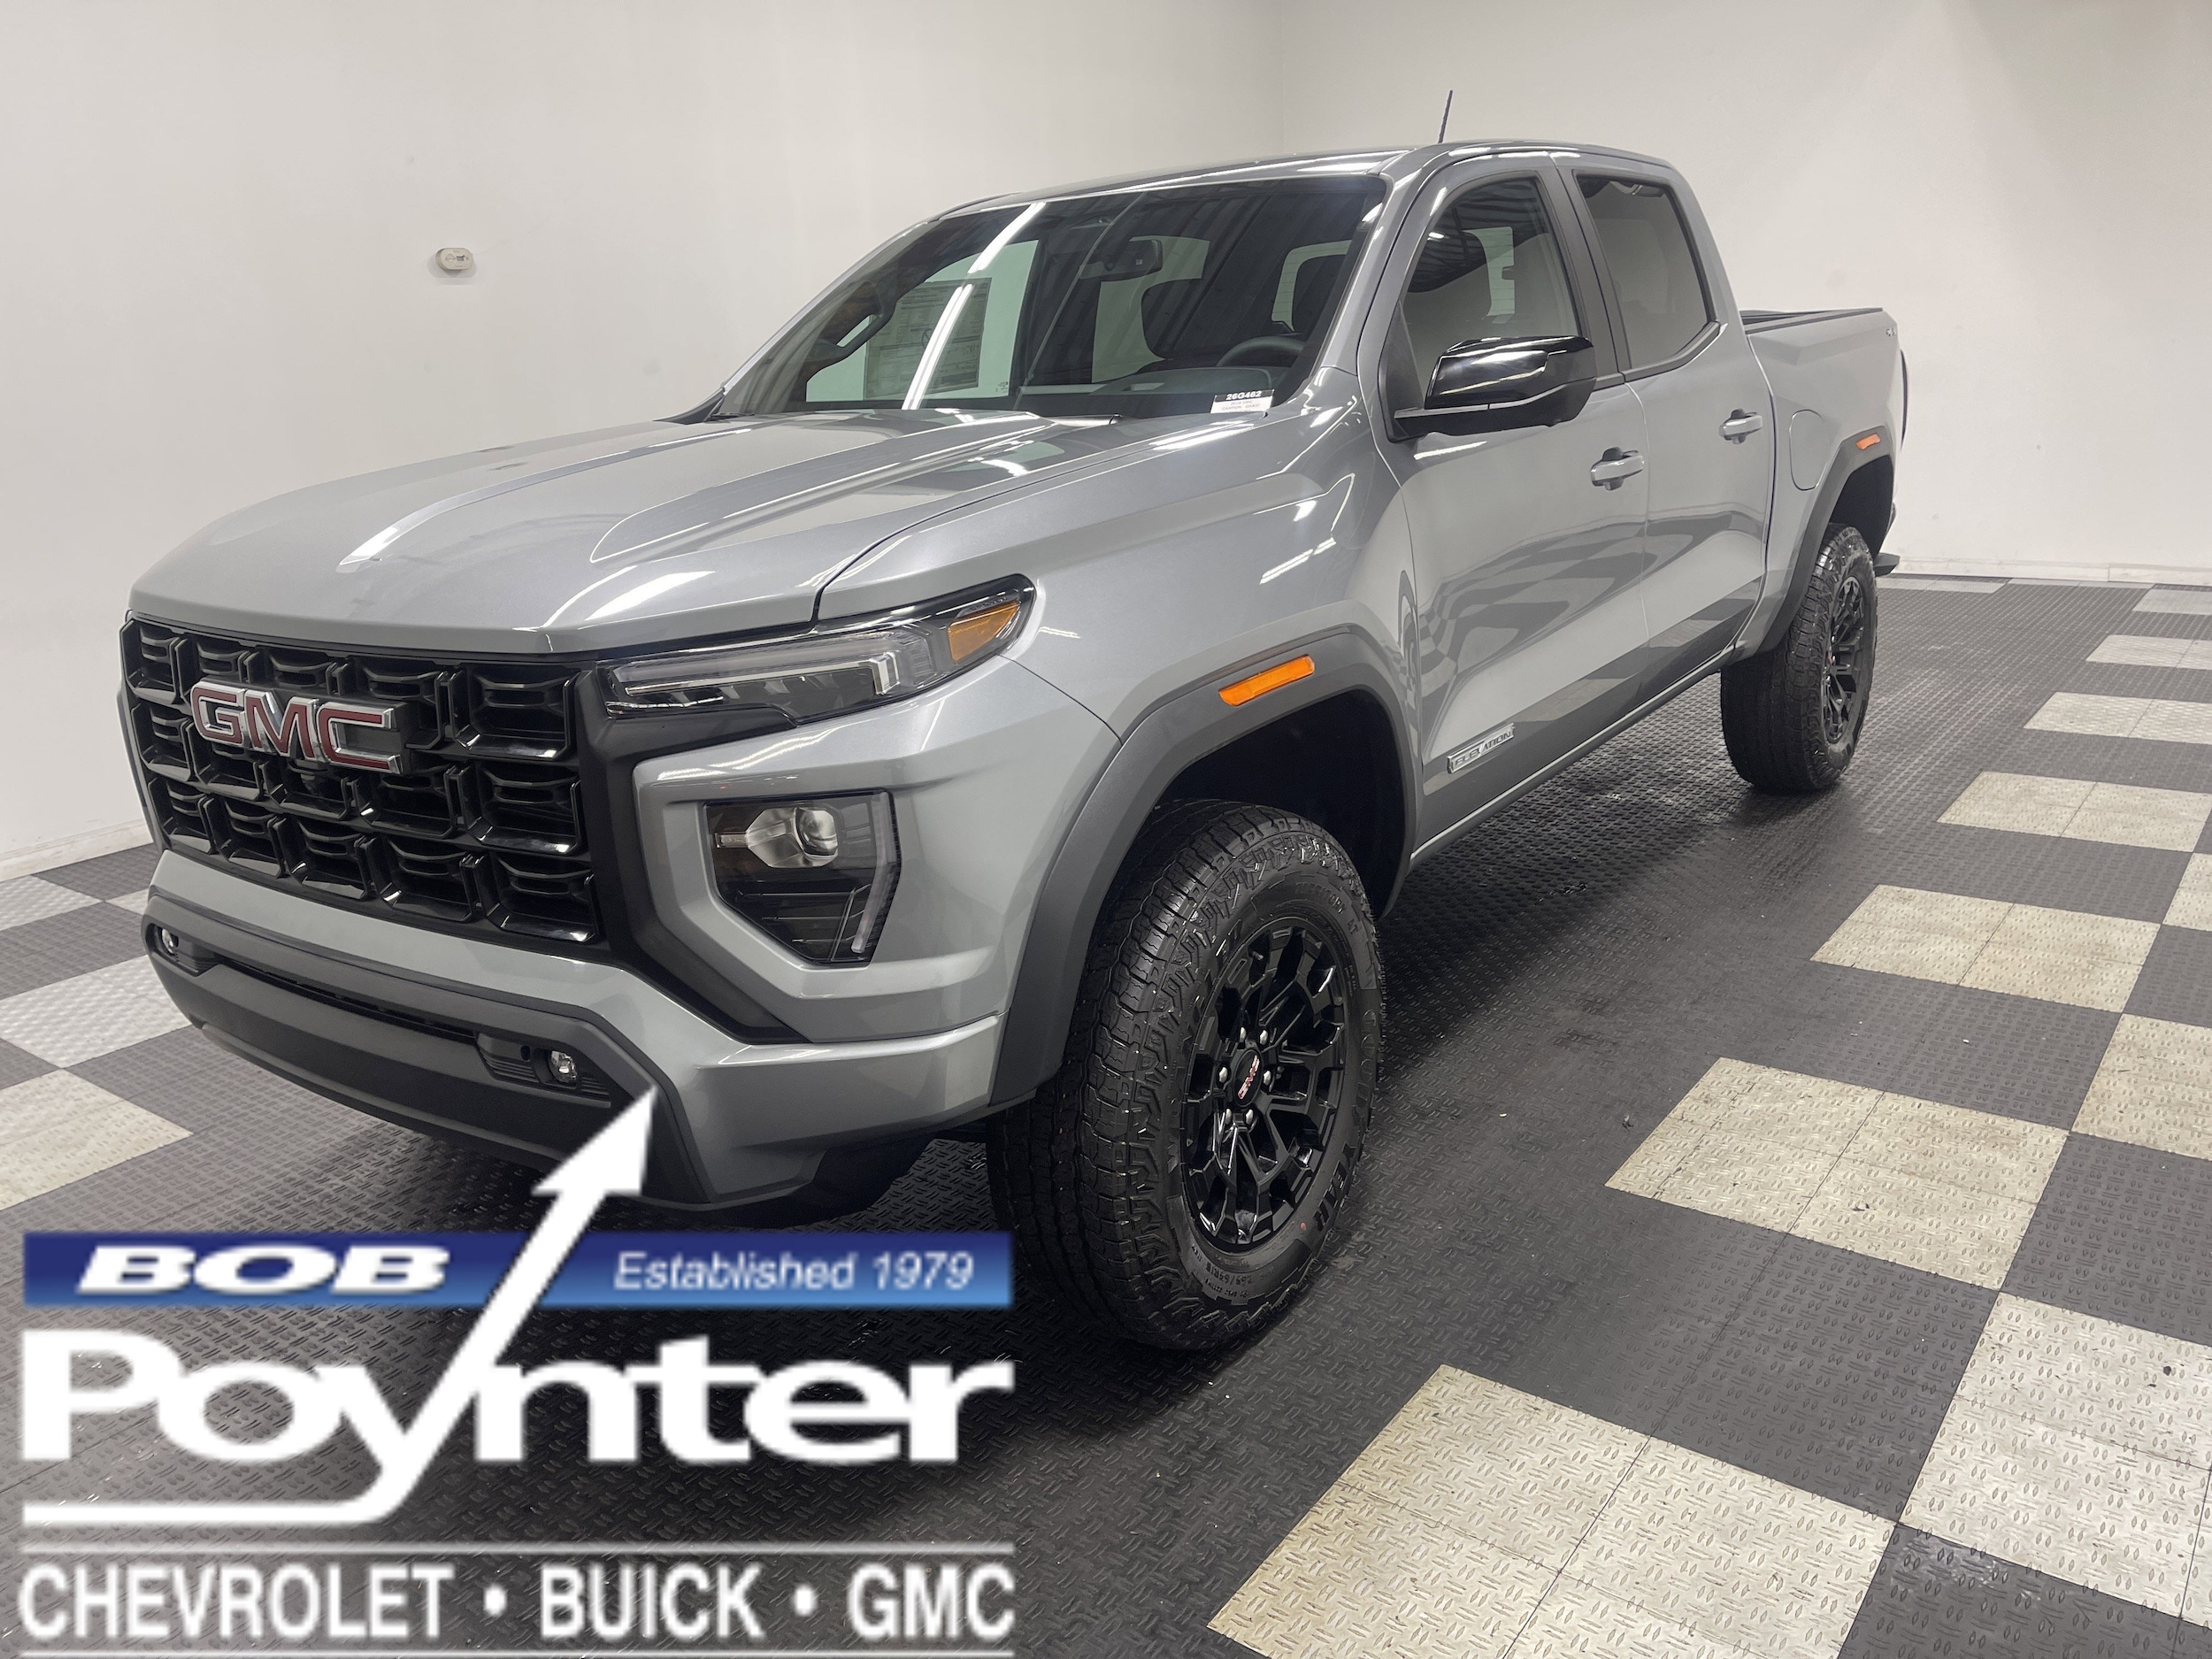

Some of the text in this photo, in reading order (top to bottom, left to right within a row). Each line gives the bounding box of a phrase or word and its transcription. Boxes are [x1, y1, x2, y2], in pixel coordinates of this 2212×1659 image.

[1225, 390, 1263, 401] 26G462
[191, 680, 401, 774] GMC
[1454, 731, 1511, 766] ELEVATION
[1238, 1055, 1260, 1100] GMC
